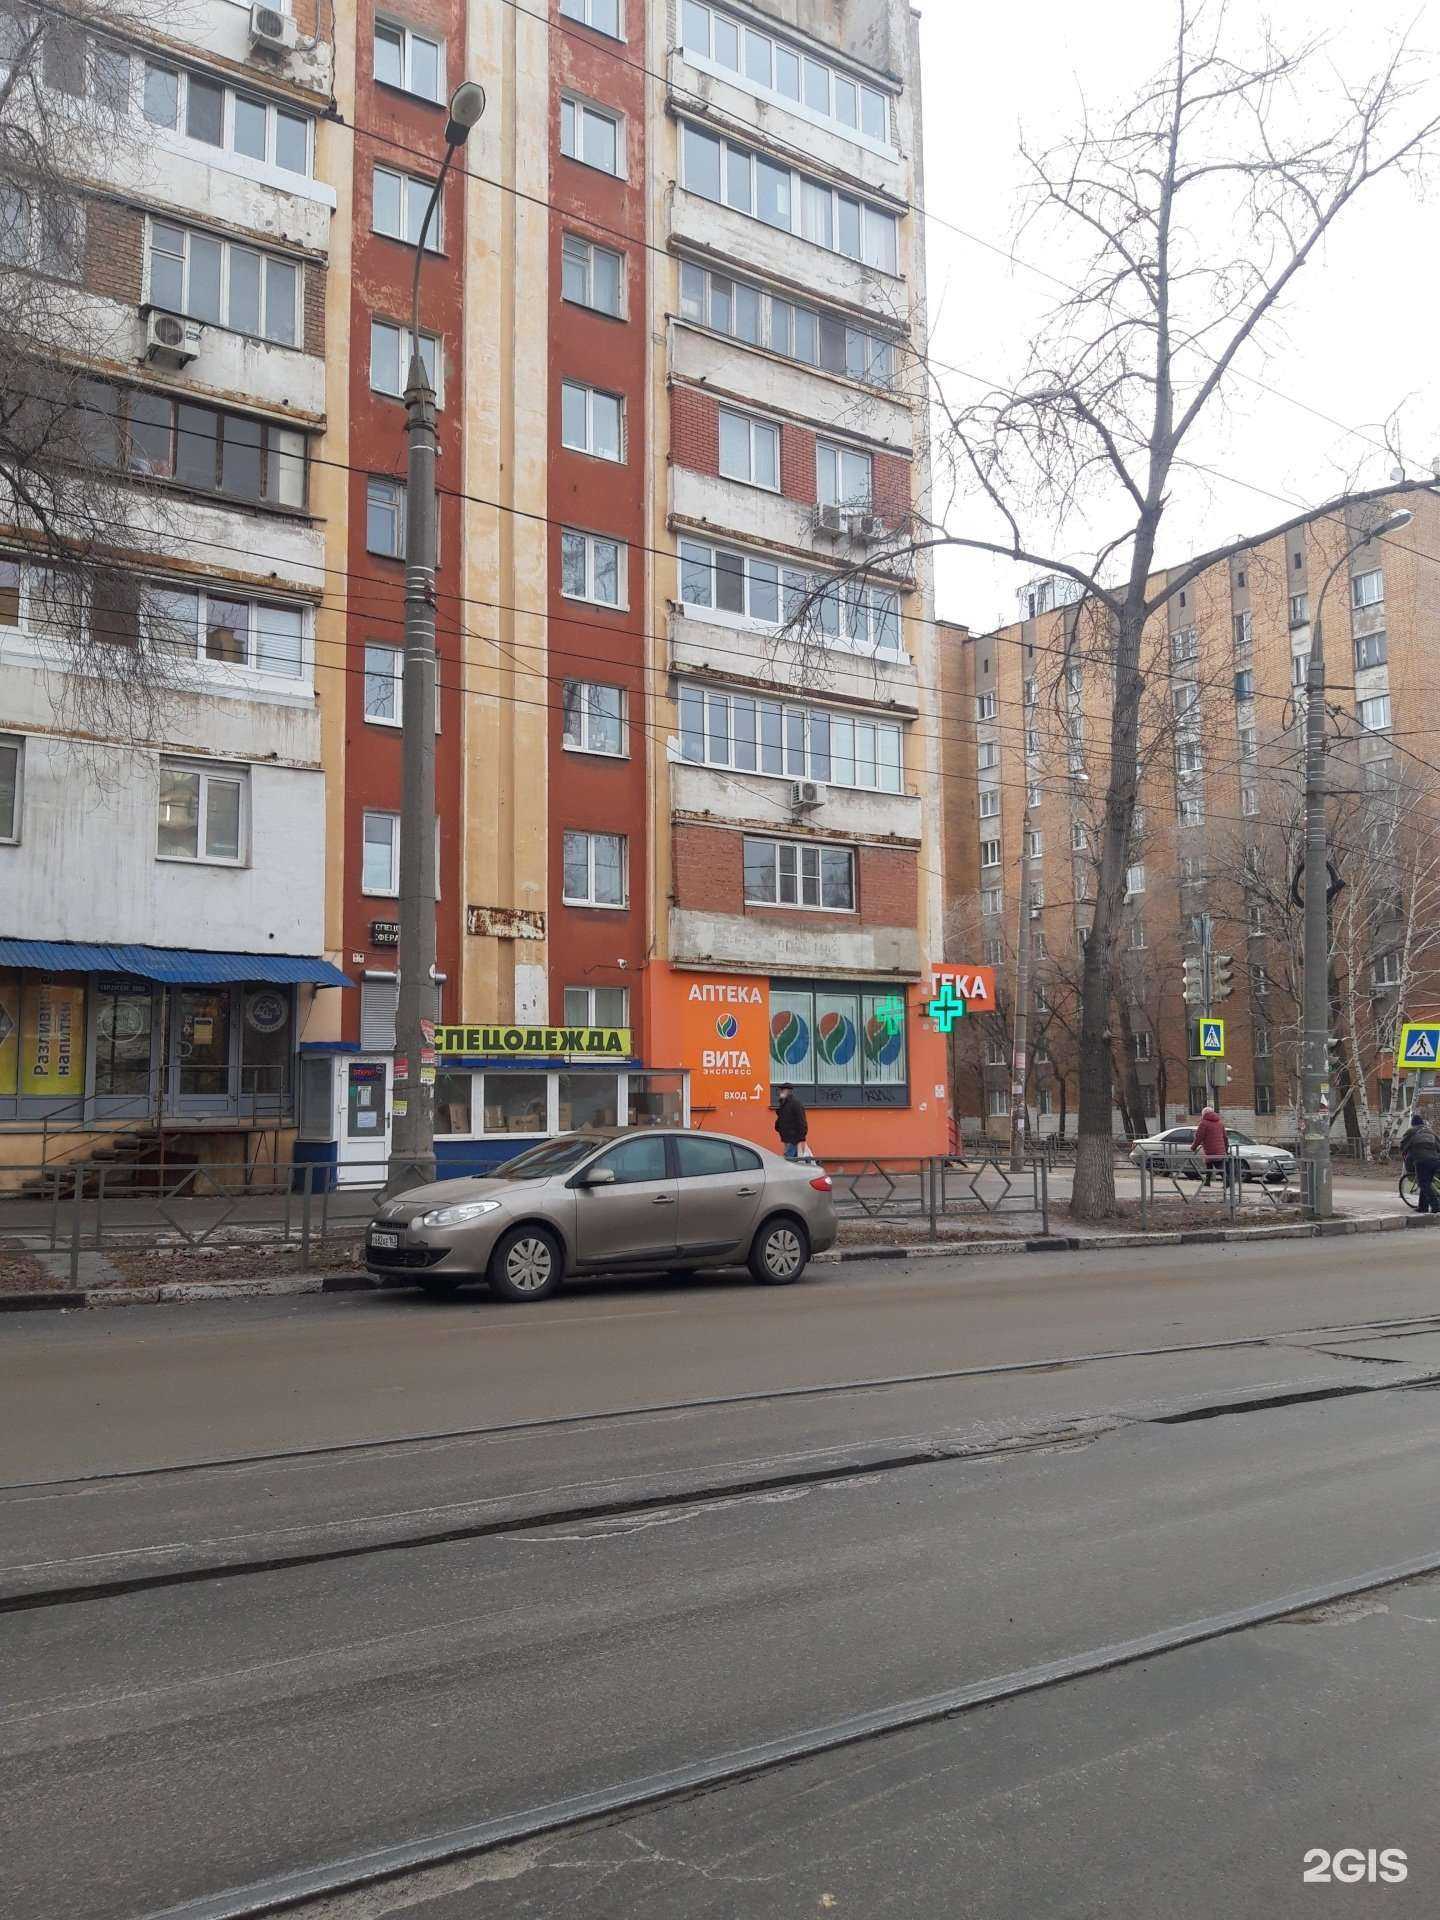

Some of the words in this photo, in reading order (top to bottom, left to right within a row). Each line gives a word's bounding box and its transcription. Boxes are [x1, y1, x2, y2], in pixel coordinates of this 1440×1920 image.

[688, 983, 763, 1004] АПТЕКА
[702, 1050, 752, 1068] ВИТА
[703, 1068, 752, 1076] ЭКСПРЕСС
[724, 1091, 747, 1101] ВХОД
